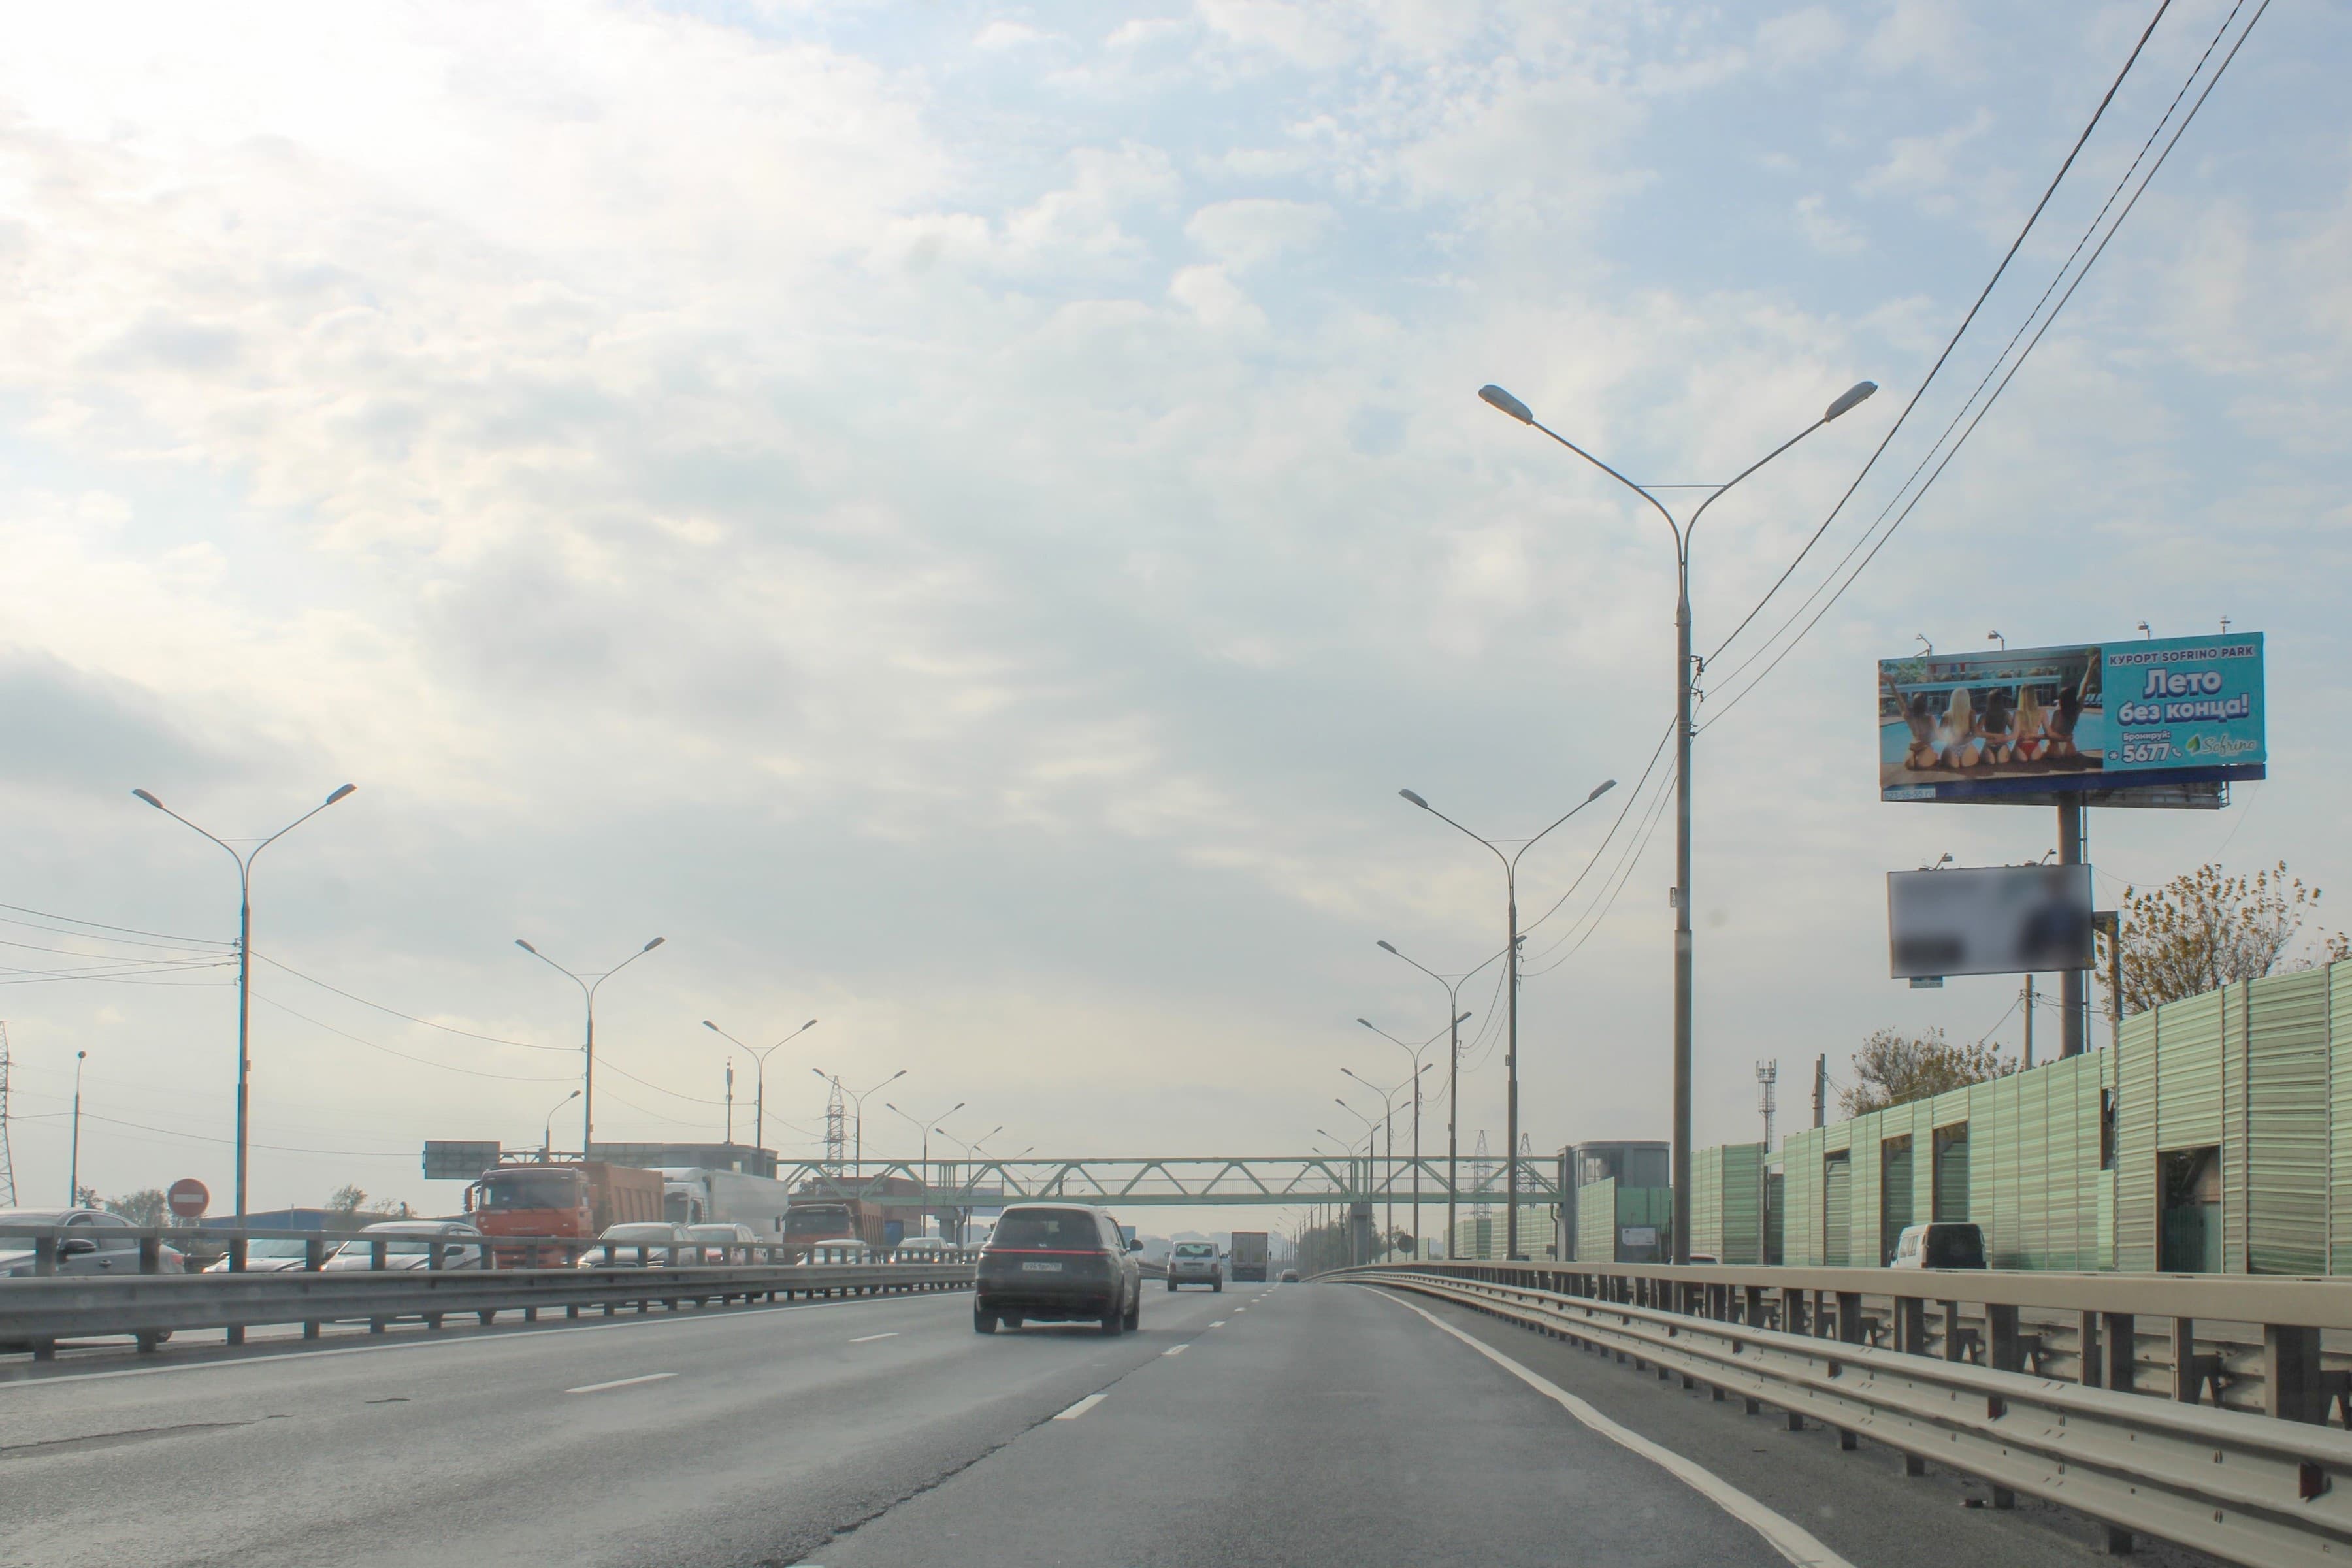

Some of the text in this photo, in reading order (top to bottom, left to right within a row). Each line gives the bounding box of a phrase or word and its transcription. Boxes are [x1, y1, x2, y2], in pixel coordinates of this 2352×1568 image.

[2109, 646, 2254, 665] КУРОРТ SOFRINO PARK
[2142, 668, 2222, 699] Лето
[2117, 692, 2249, 725] без конца!
[2122, 730, 2171, 743] Бронируй:
[2202, 735, 2256, 756] Sofrino
